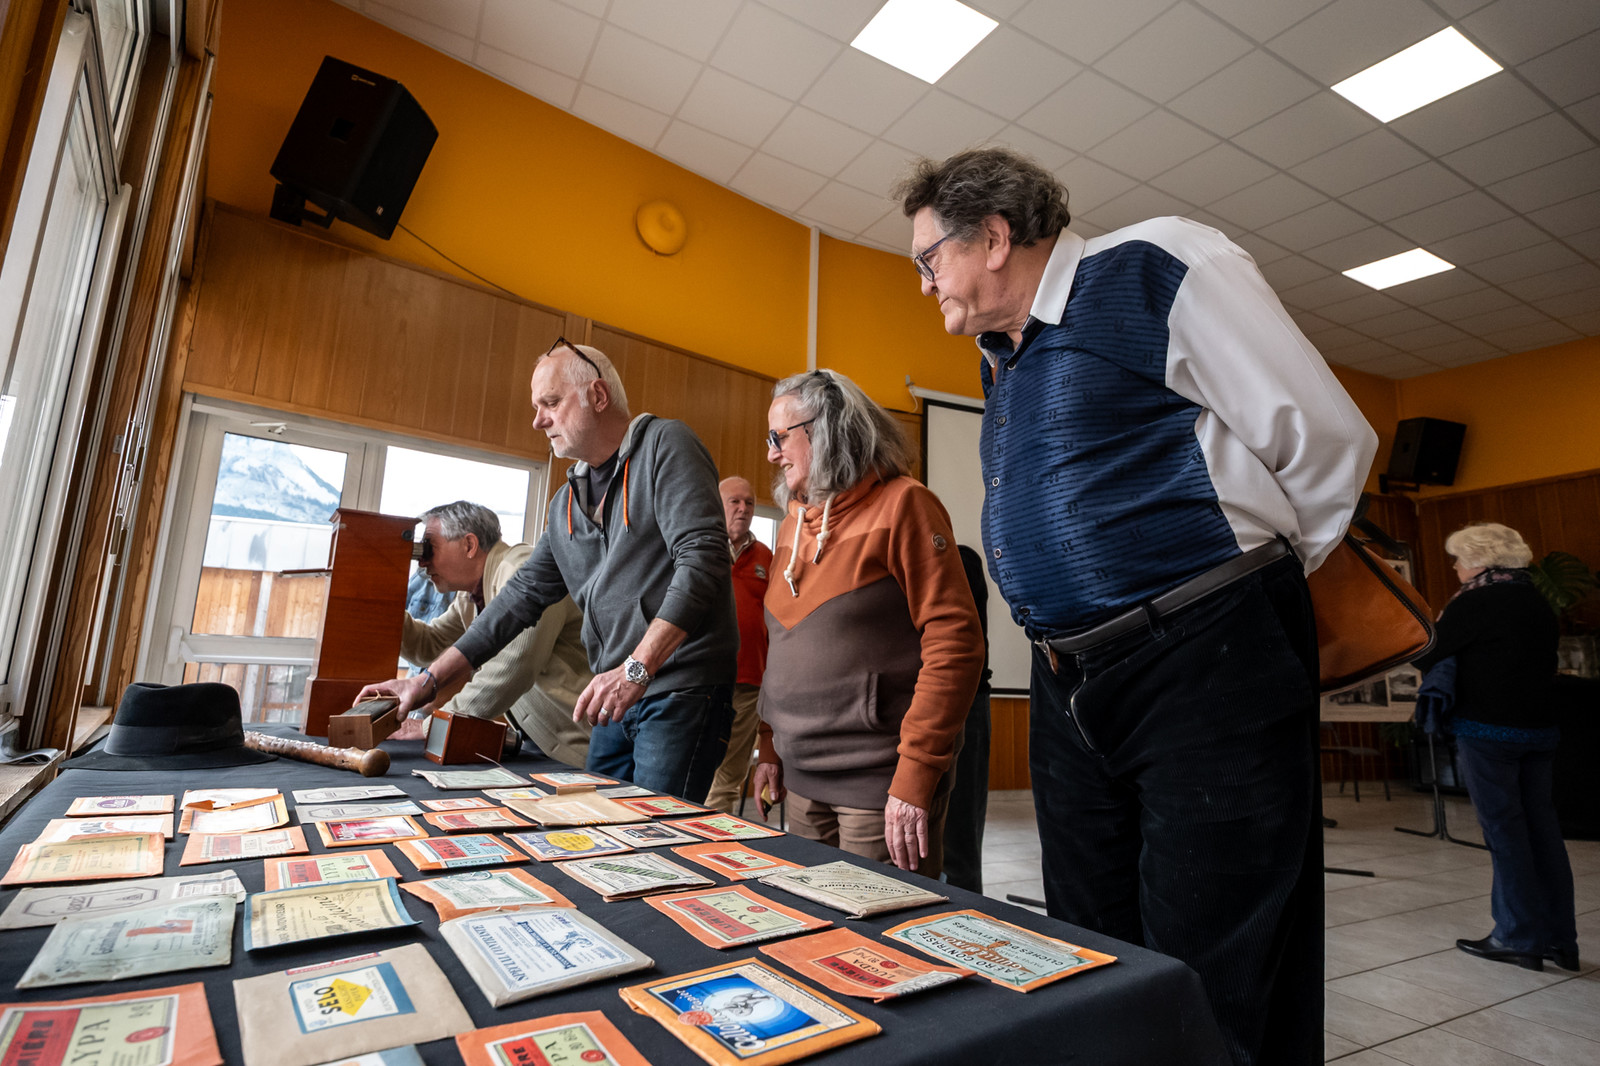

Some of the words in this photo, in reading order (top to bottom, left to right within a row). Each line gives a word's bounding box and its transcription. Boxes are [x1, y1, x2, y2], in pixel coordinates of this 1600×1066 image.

[714, 901, 760, 924] LYPA
[917, 931, 975, 961] CONTRASTE
[853, 959, 896, 978] LUGDA
[313, 985, 342, 1015] SELO
[16, 1020, 54, 1066] MIÈRE
[70, 1018, 110, 1066] YPA
